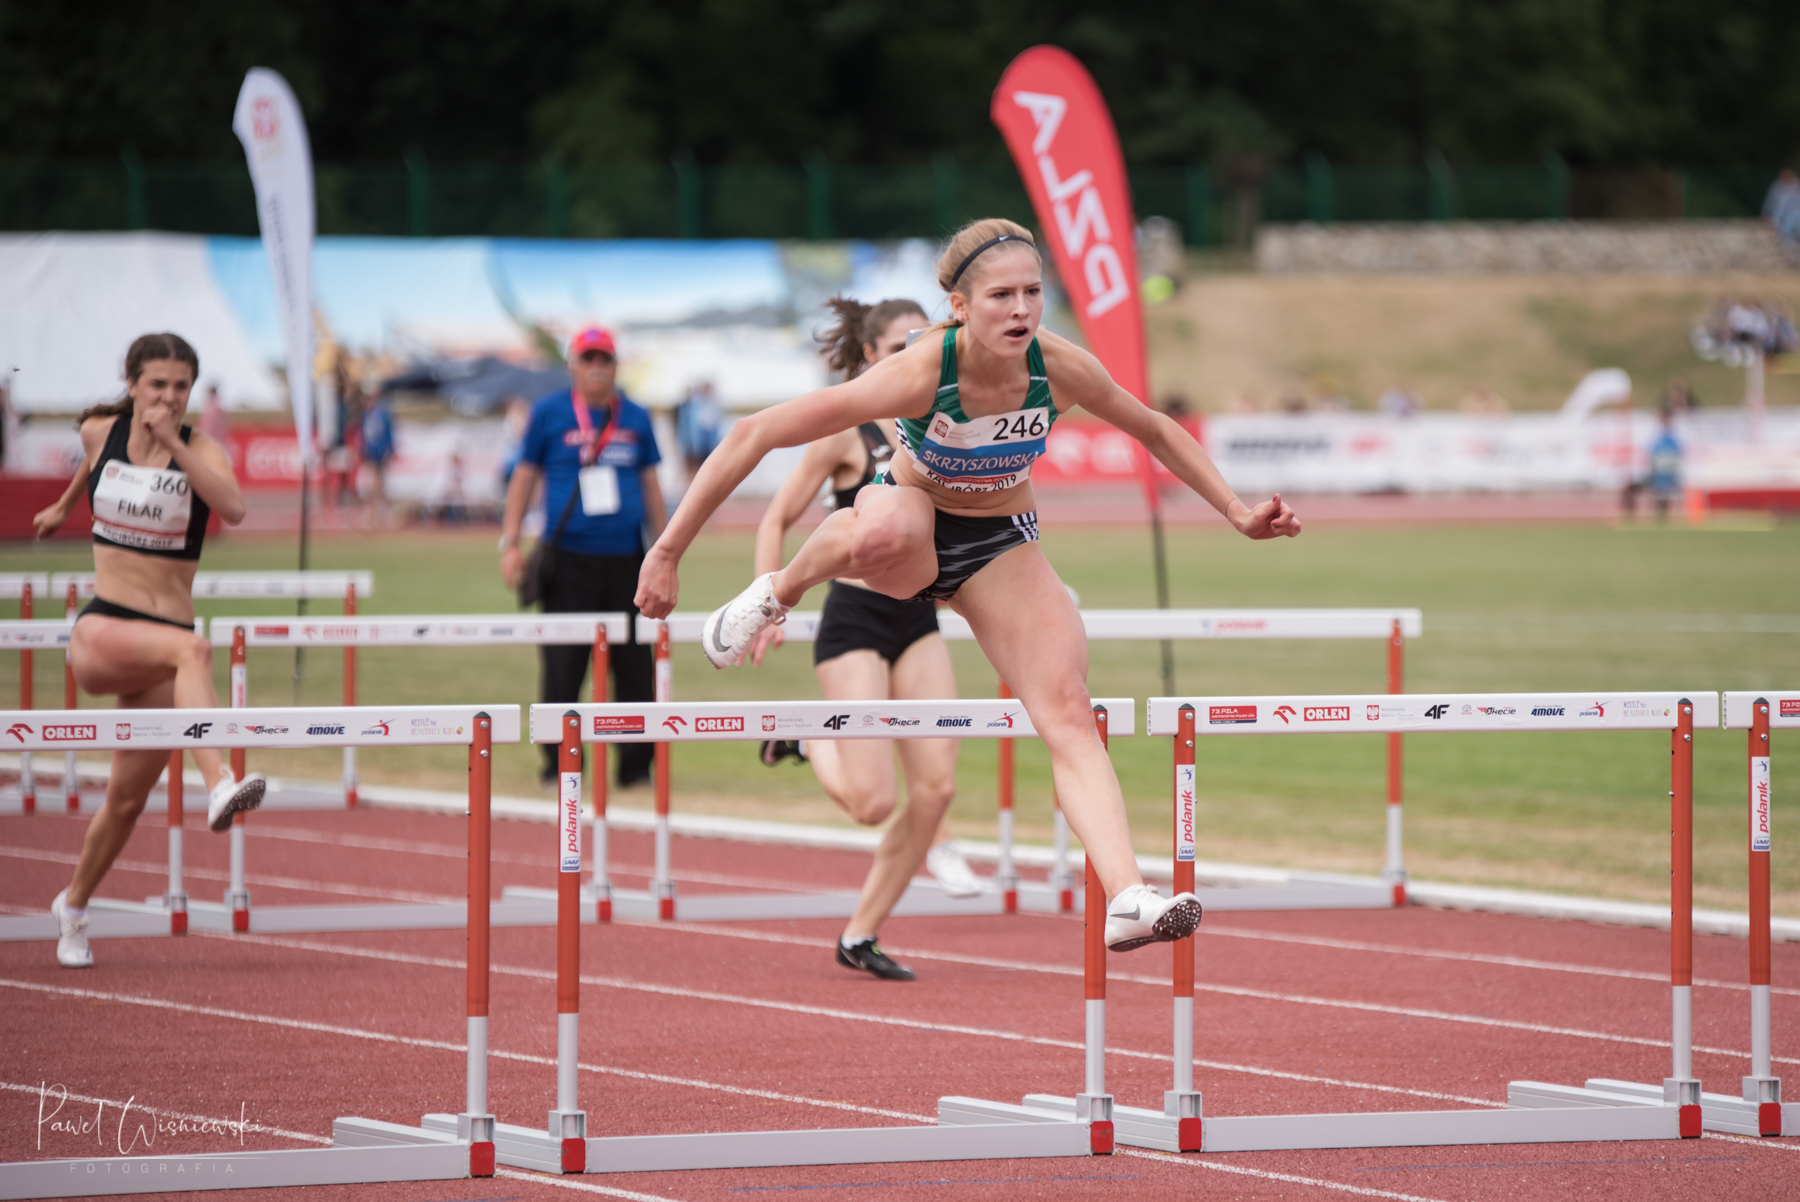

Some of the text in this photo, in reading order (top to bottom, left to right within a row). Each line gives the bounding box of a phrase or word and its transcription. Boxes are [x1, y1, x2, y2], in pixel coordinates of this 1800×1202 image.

[992, 413, 1044, 441] 246
[923, 450, 1039, 472] SKRZYSZOWSKA
[150, 474, 188, 497] 360
[991, 474, 1017, 491] 2019
[117, 499, 163, 522] FILAR
[1305, 707, 1348, 720] ORLEN
[1424, 704, 1450, 720] 4F
[1531, 708, 1565, 716] 4MOVE
[183, 723, 213, 739] 4F
[306, 726, 345, 736] 4MOVE
[697, 719, 742, 731] ORLEN
[823, 715, 850, 731] 4F
[936, 719, 973, 728] 4MOVE
[987, 721, 1008, 729] polanik
[44, 727, 94, 740] ORLEN
[1756, 781, 1769, 833] polanik
[1181, 789, 1194, 843] polanik
[565, 798, 578, 853] polanik
